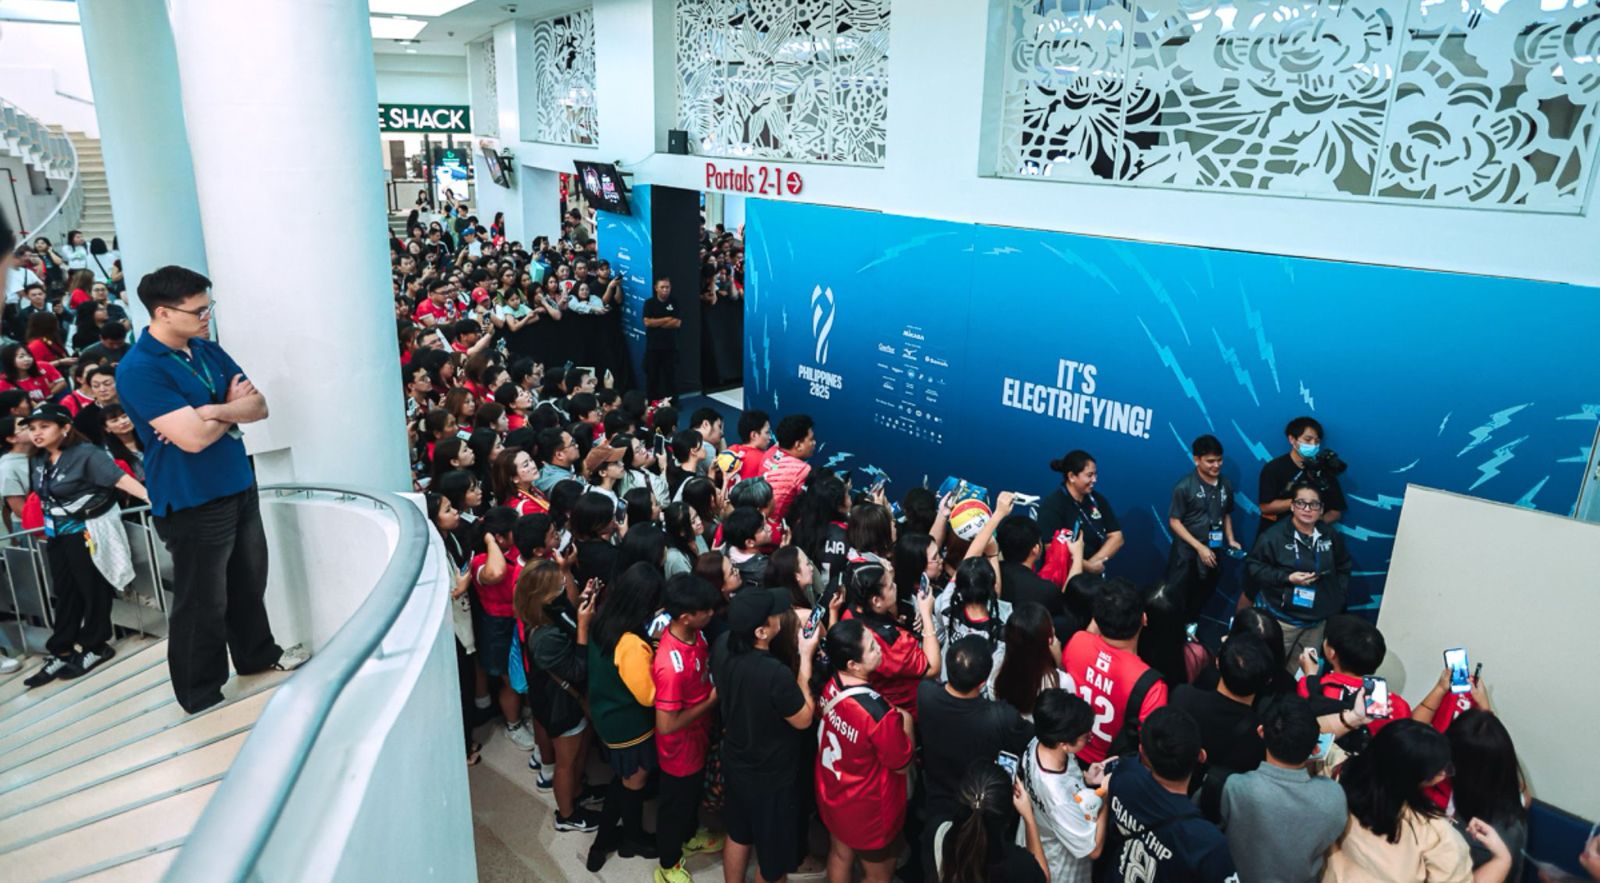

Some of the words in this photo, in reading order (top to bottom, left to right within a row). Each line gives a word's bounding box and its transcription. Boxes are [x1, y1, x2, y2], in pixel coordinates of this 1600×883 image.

[389, 107, 466, 129] SHACK
[705, 162, 755, 193] Portals
[758, 166, 782, 196] 2-1
[797, 364, 843, 390] PHILIPPINES
[809, 381, 830, 400] 2025
[1056, 358, 1098, 395] IT'S
[1001, 376, 1153, 439] ELECTRIFYING!
[1085, 665, 1114, 696] RAN
